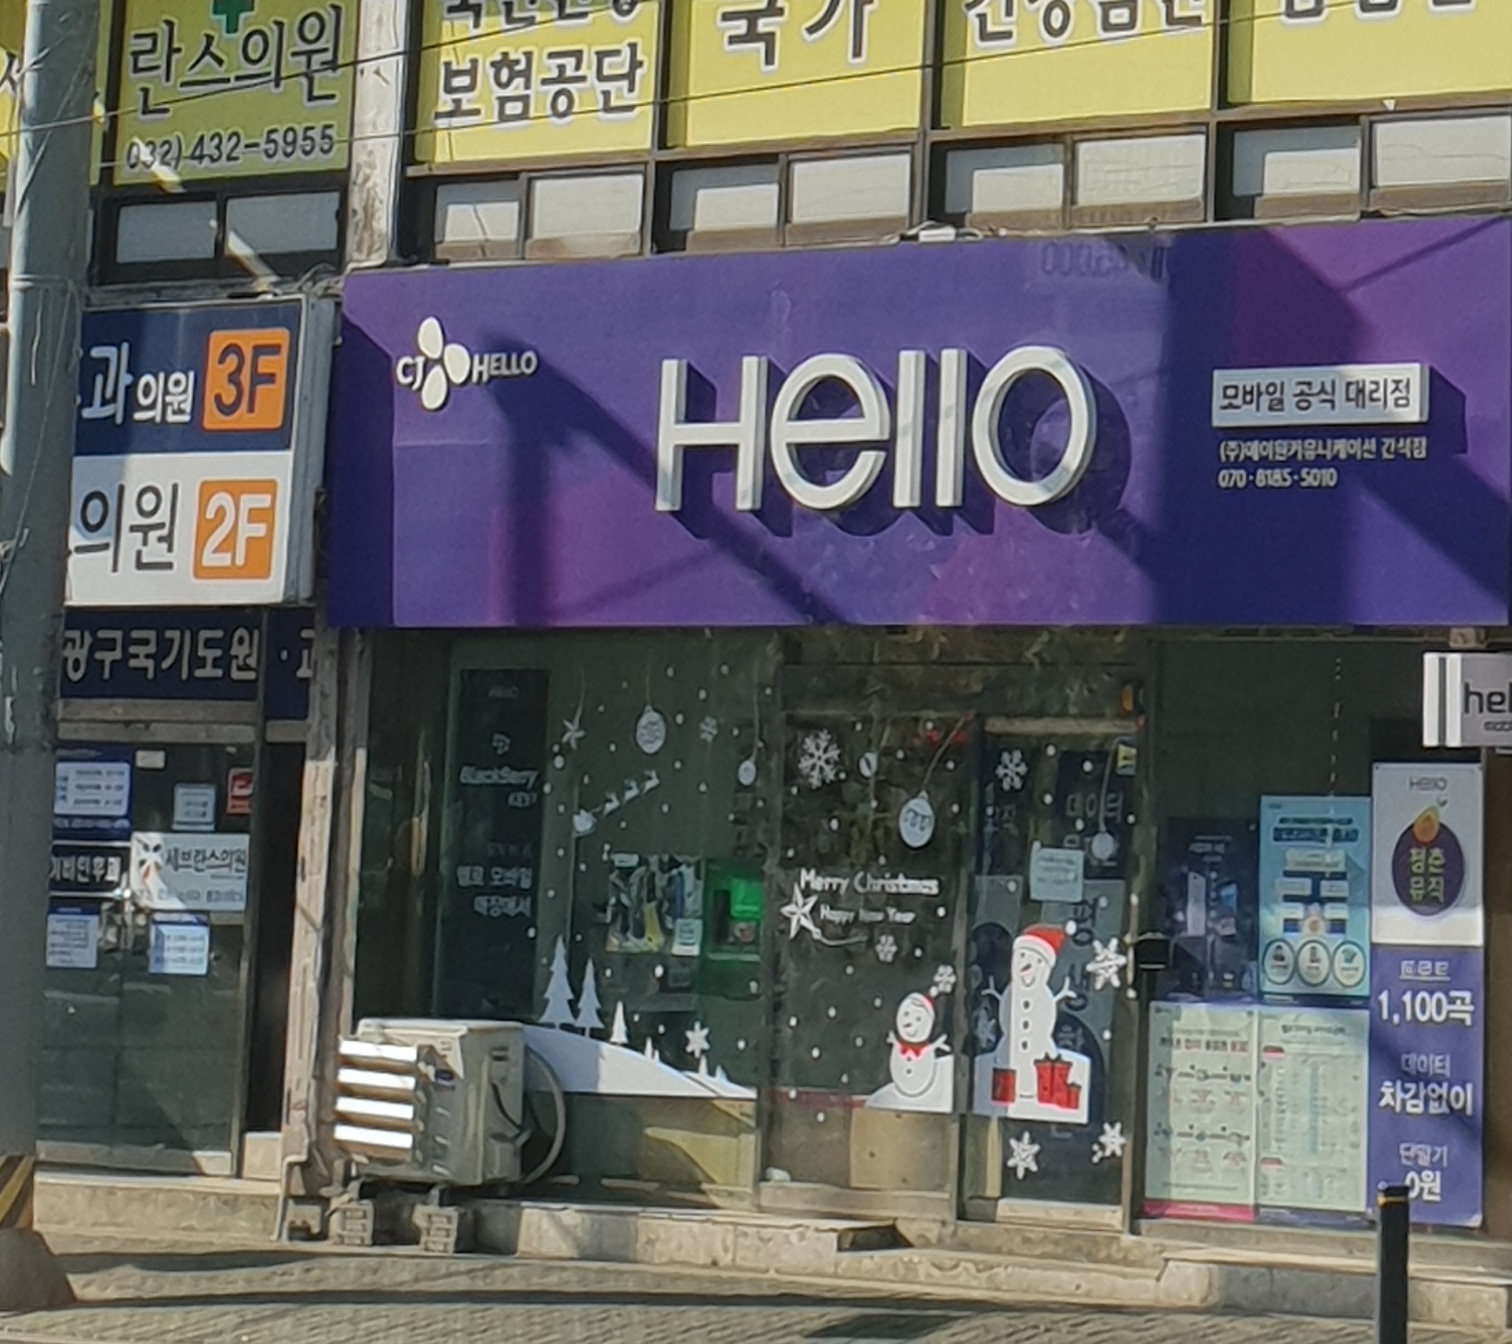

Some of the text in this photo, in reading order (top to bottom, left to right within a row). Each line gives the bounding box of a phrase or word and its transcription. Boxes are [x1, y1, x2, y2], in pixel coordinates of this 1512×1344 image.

[434, 41, 645, 126] 보험공단
[212, 341, 284, 420] 3F
[396, 350, 538, 390] CJ HELLO
[1219, 377, 1412, 413] 모바일 공식 대리점
[655, 346, 1098, 513] Hello
[200, 489, 273, 569] 2F
[1377, 989, 1475, 1026] 1,100곡
[1378, 1080, 1473, 1116] 차감없이
